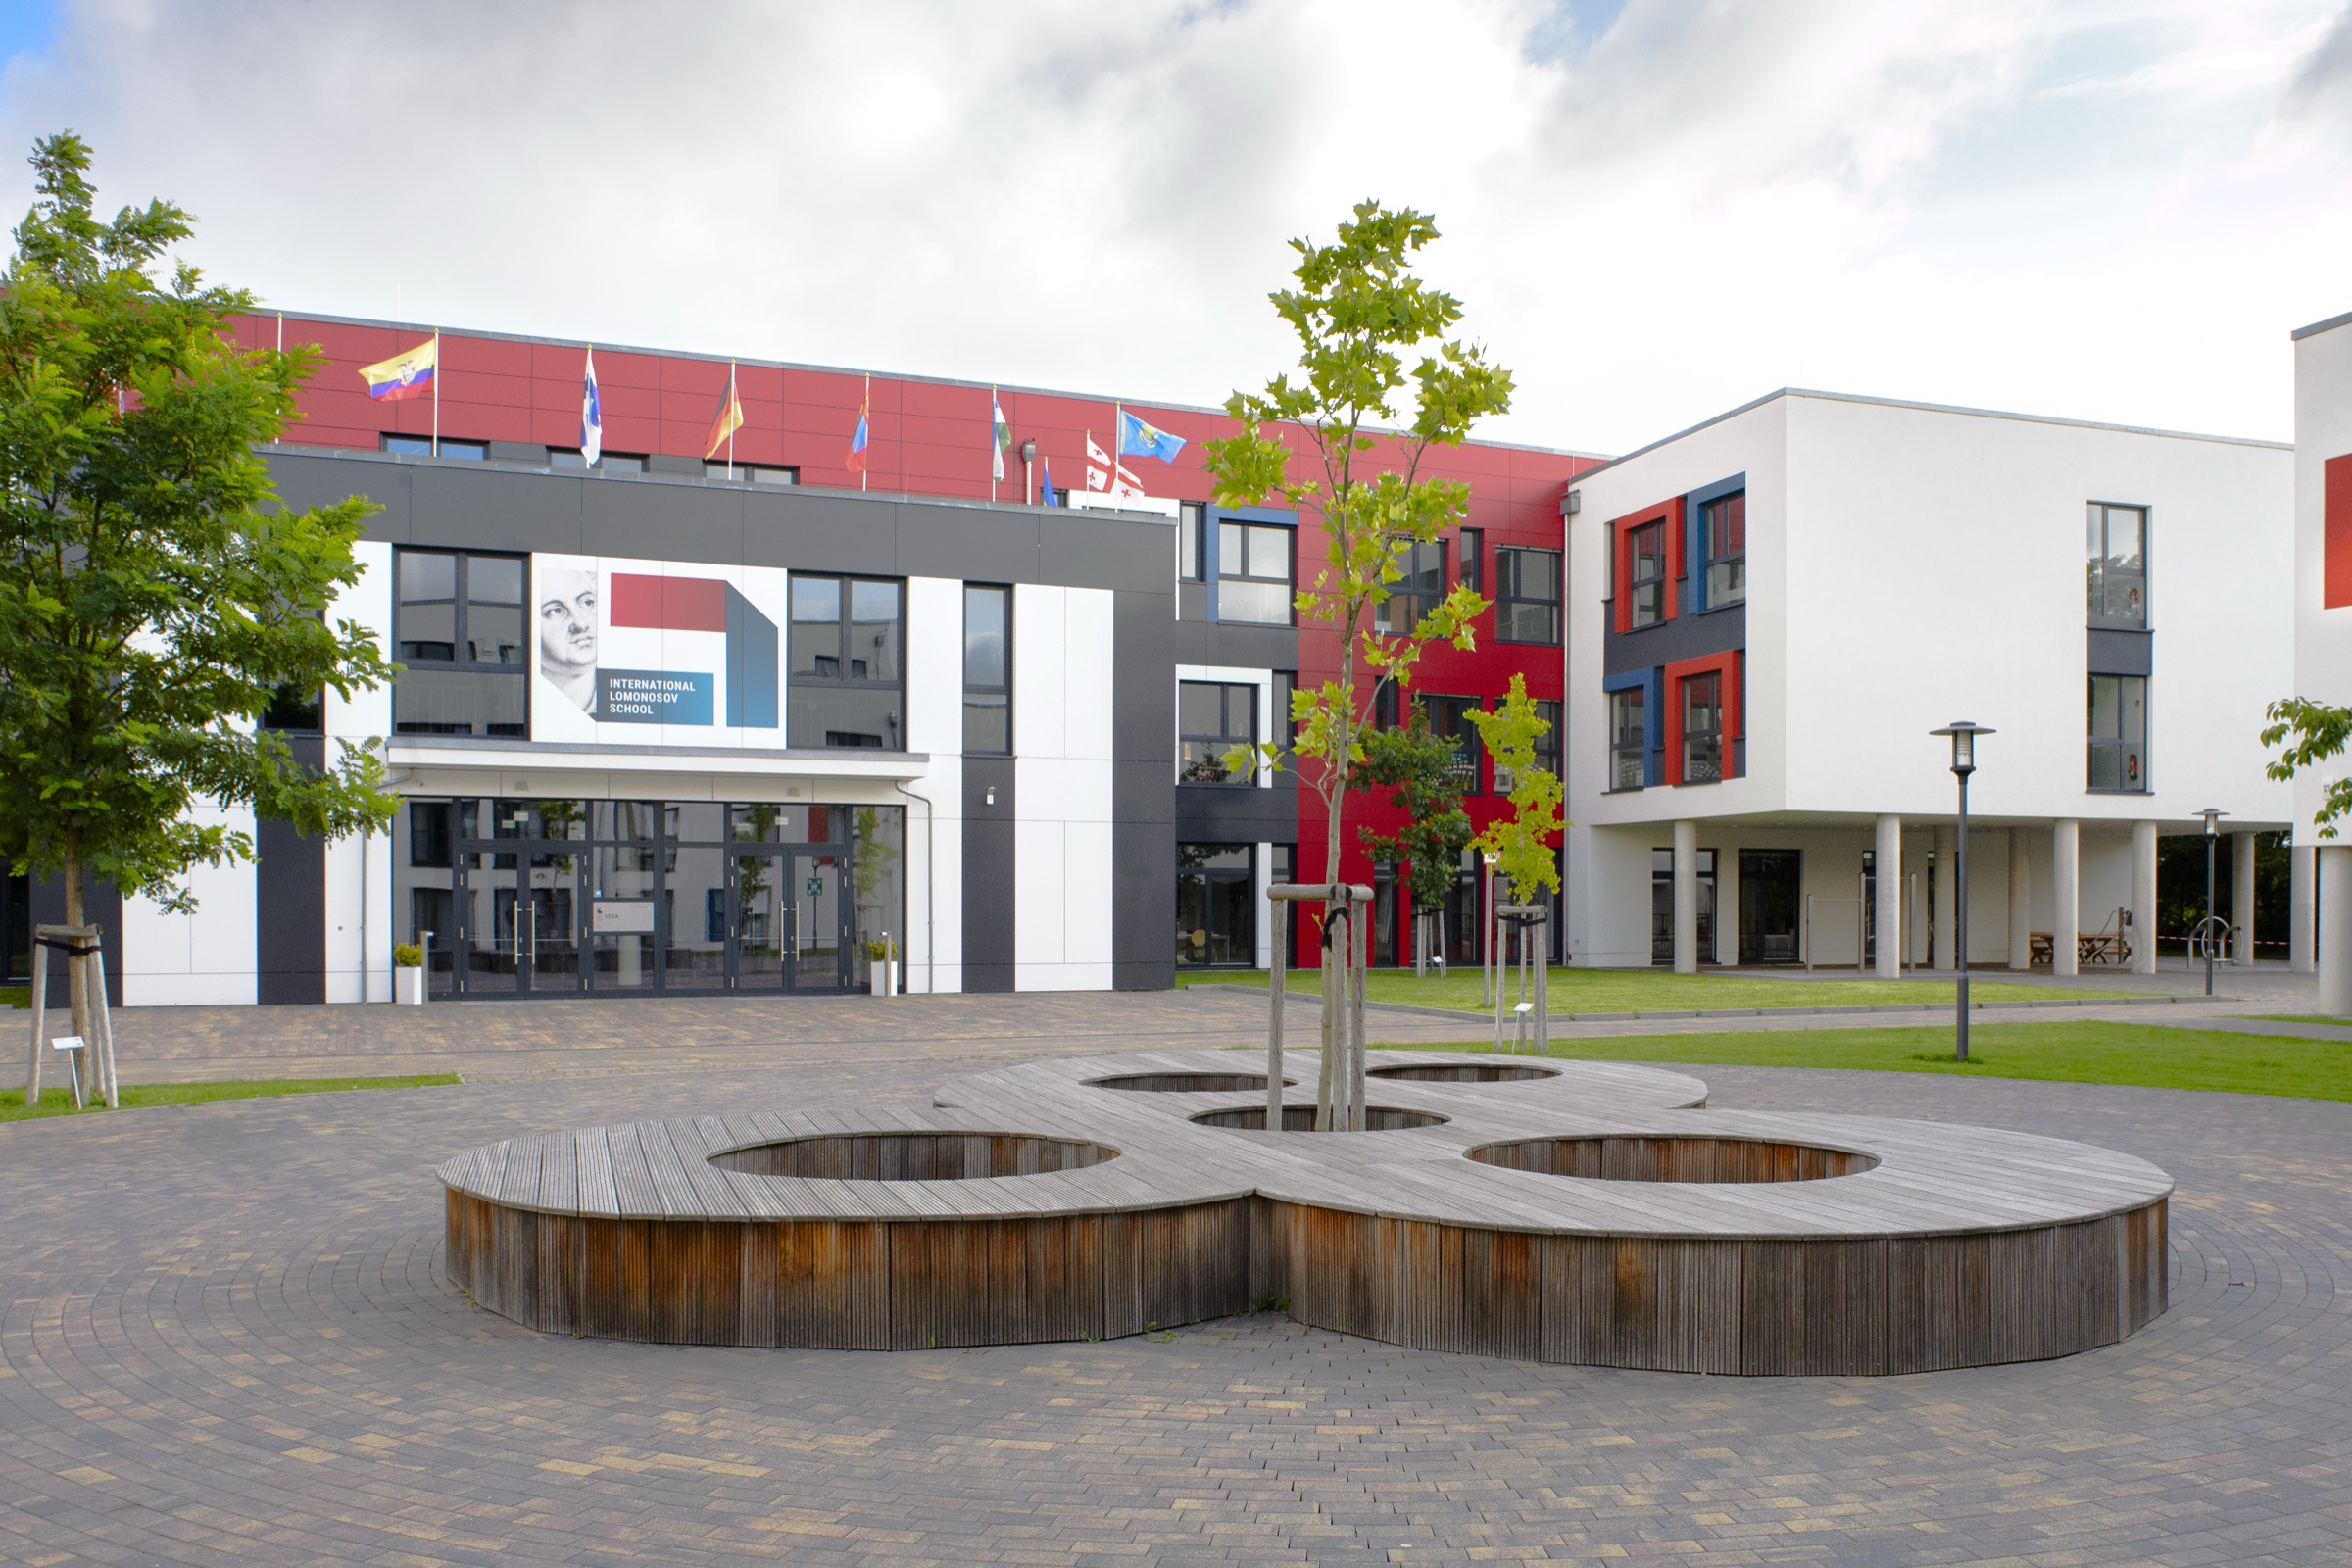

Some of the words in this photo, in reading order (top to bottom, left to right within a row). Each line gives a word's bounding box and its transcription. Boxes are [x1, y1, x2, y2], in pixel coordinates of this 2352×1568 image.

[610, 678, 696, 692] INTERNATIONAL
[610, 691, 678, 703] LOMONOSOV
[610, 703, 654, 714] SCHOOL
